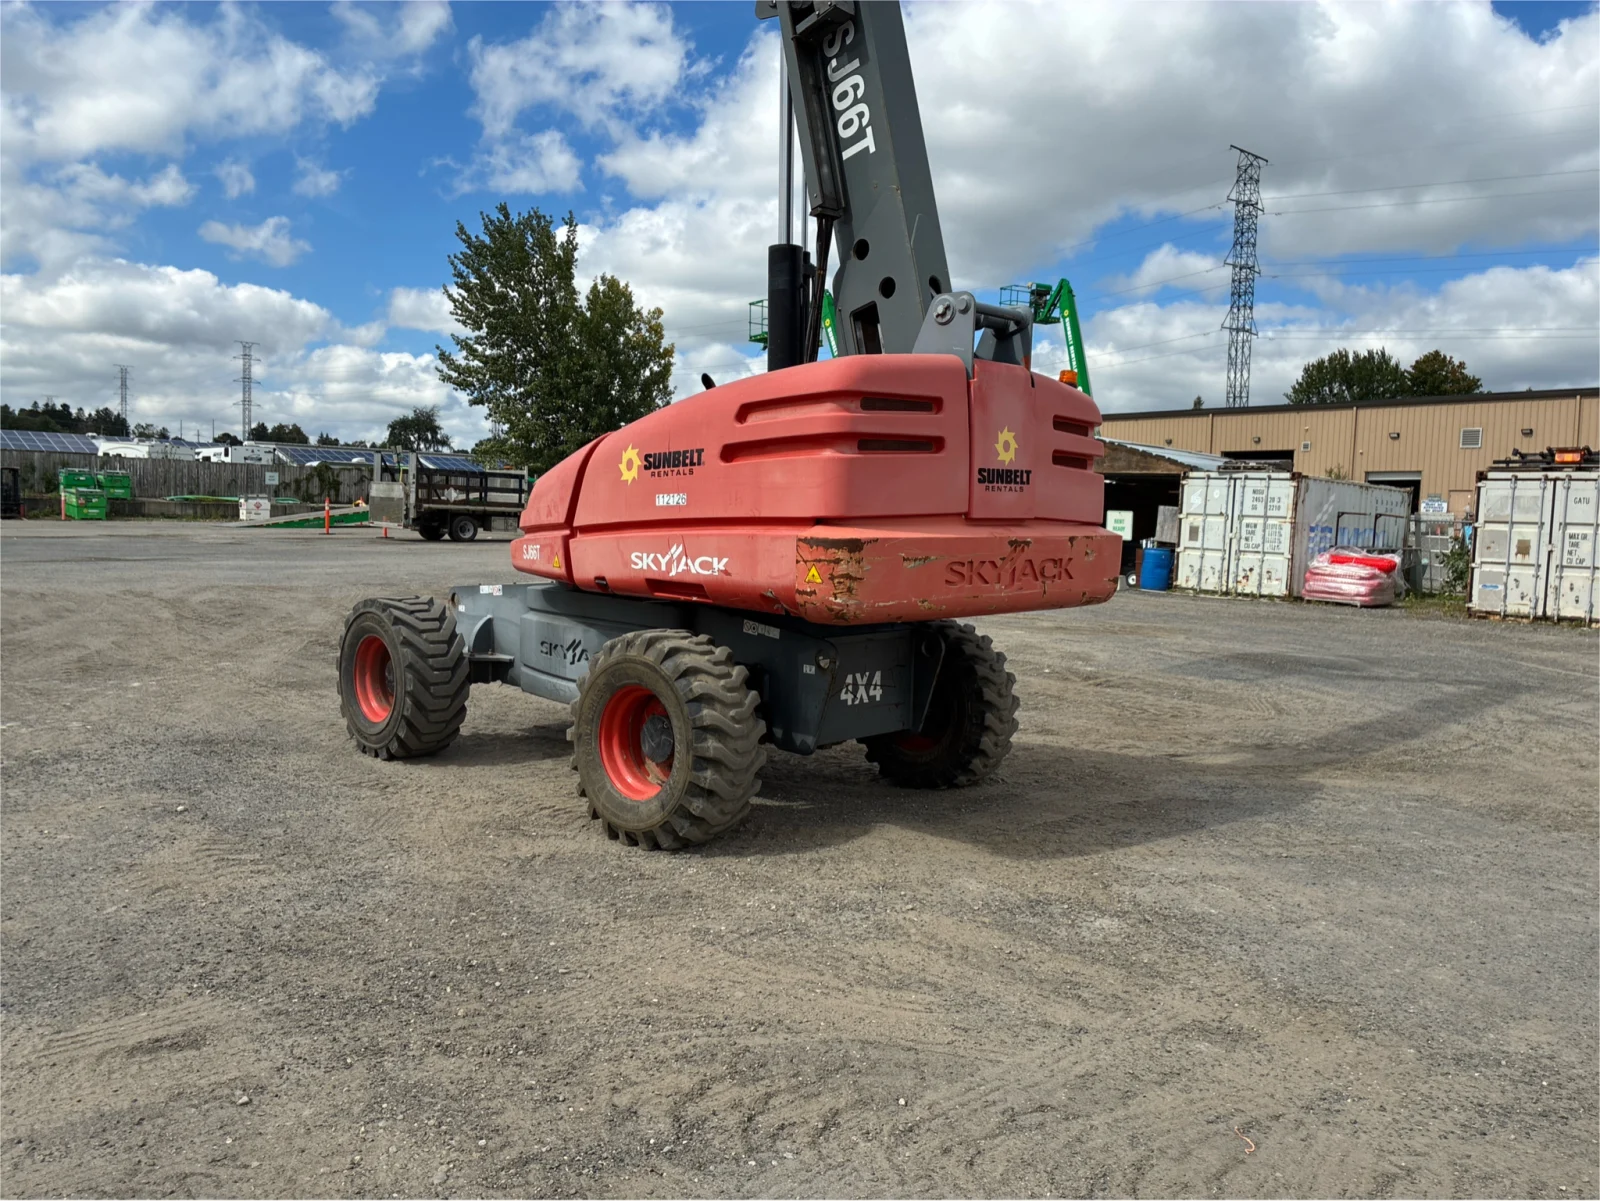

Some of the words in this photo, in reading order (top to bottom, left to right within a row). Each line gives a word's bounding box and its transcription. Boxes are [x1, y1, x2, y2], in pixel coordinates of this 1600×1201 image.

[822, 19, 876, 161] SJ66T
[643, 448, 705, 471] SUNBELT
[650, 468, 694, 478] RENTALS
[977, 467, 1032, 485] SUNBELT
[985, 485, 1024, 493] RENTALS
[656, 493, 687, 505] 112126
[1573, 496, 1590, 505] GATU
[523, 544, 540, 560] SJ66T
[1568, 540, 1580, 548] TARE
[630, 543, 729, 577] SKYJACK
[944, 544, 1074, 589] SKYJACK
[540, 638, 589, 665] SKYJA
[840, 670, 883, 706] 4X4
